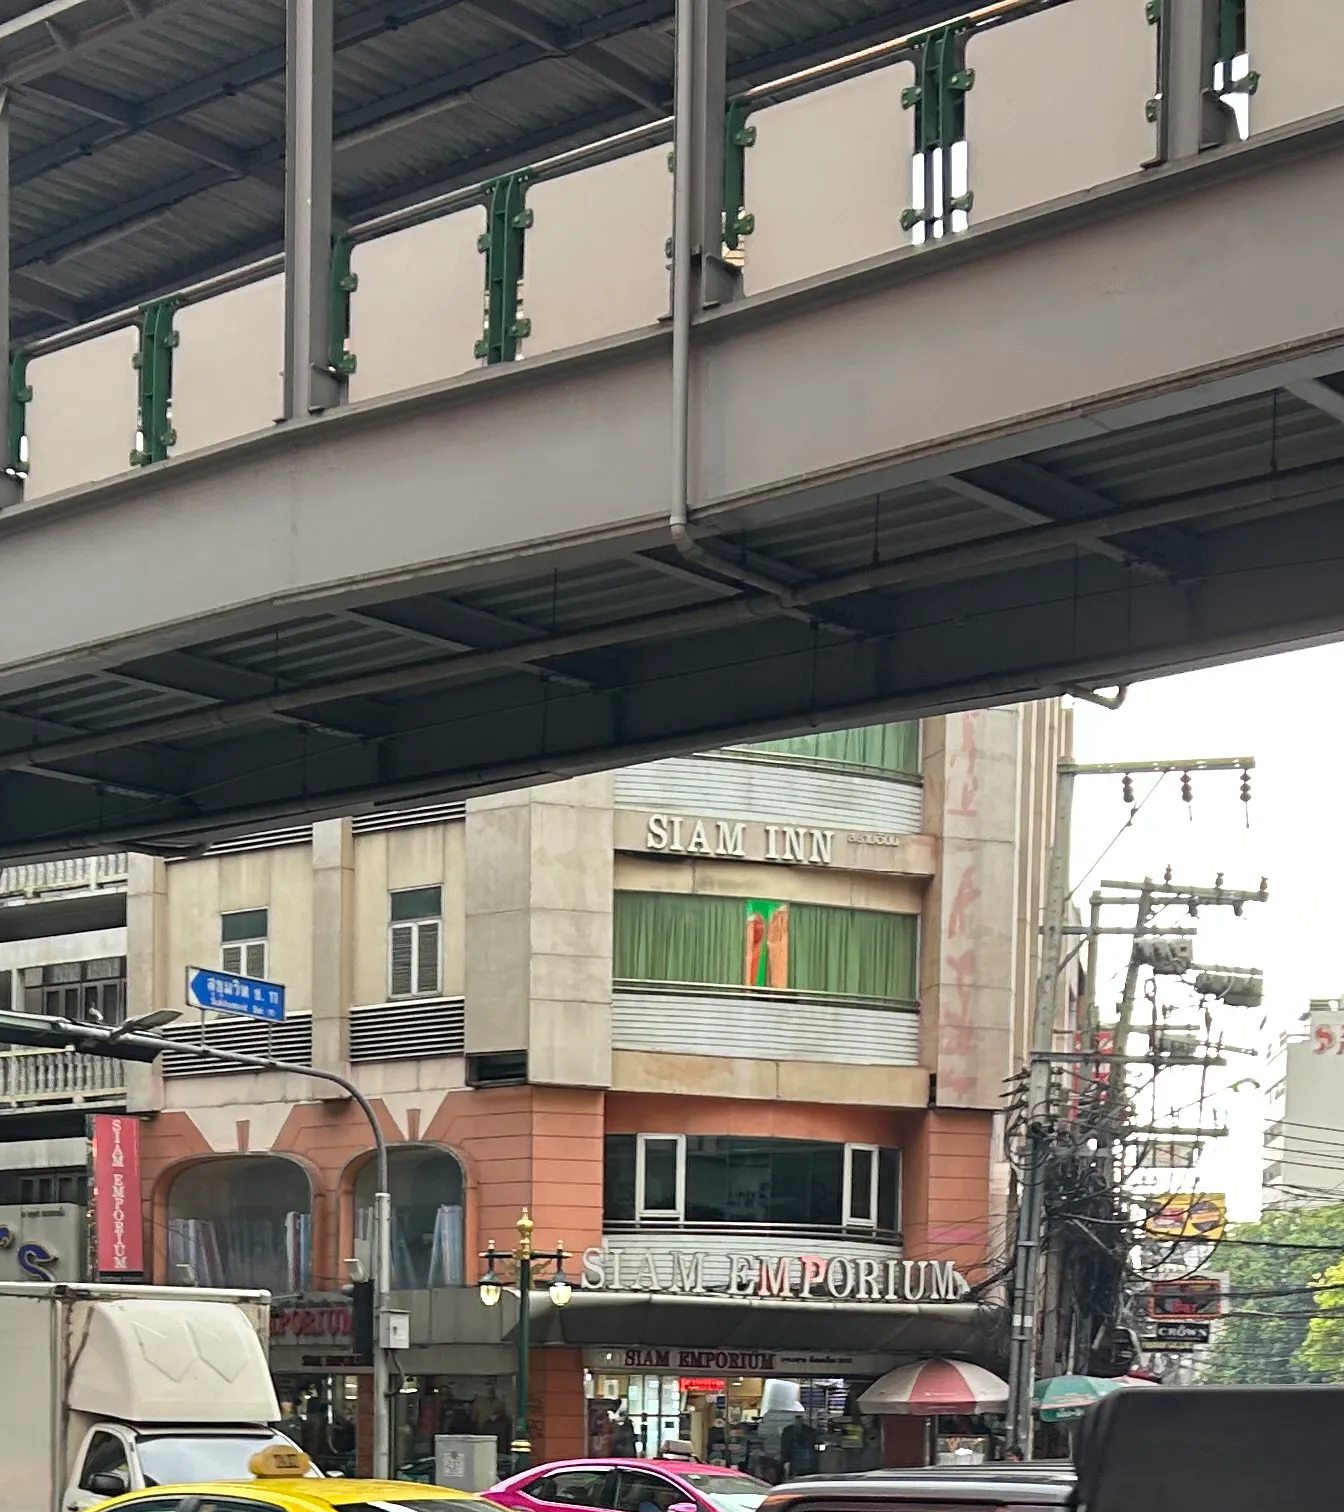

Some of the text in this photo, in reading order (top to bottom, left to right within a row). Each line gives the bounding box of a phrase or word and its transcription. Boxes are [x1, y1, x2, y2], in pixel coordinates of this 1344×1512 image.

[647, 813, 835, 864] SIAM INN
[111, 1118, 127, 1269] SIAM EMPORIUM
[581, 1247, 960, 1300] SIAM EMPORIUM
[624, 1349, 670, 1368] SIAM
[677, 1350, 777, 1370] EMPORIUM
